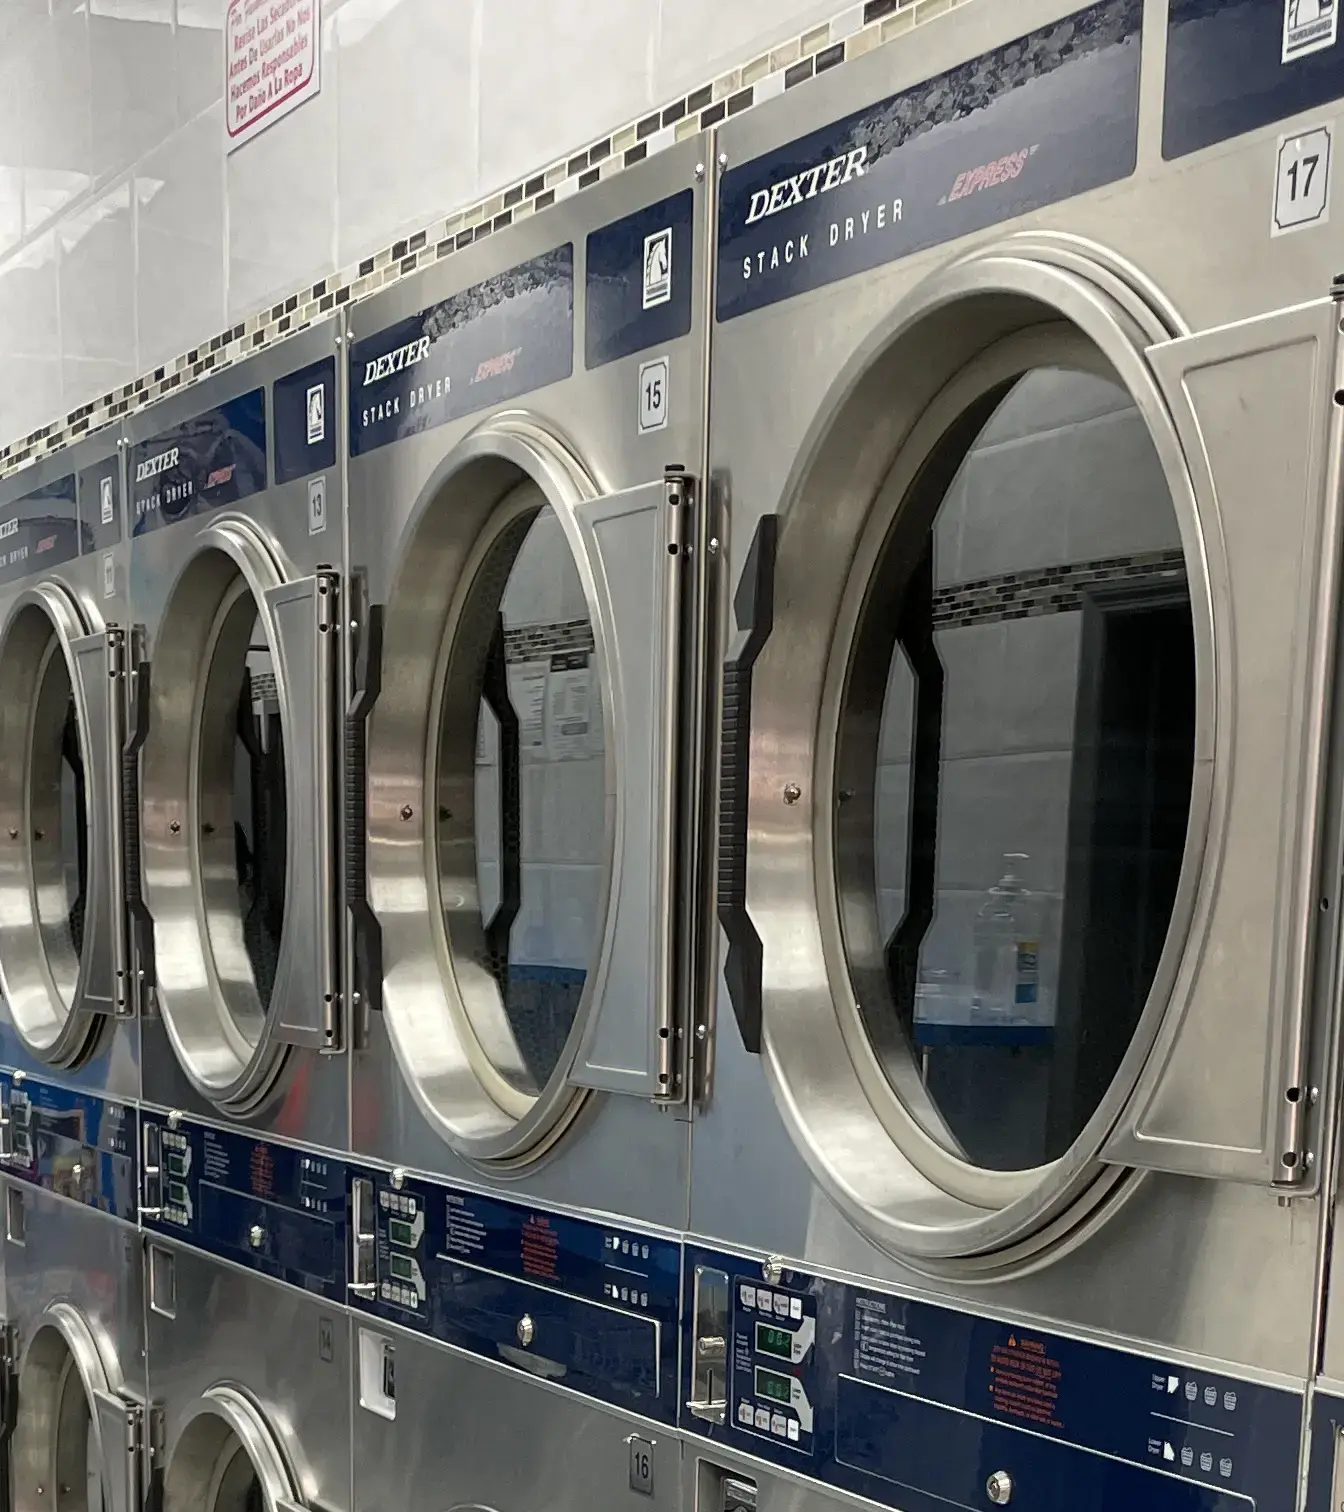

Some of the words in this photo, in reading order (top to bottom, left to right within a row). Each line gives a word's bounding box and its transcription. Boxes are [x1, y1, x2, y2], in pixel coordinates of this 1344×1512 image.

[745, 146, 868, 224] DEXTER
[948, 150, 1028, 202] EXPRESS
[1287, 154, 1319, 201] 17
[743, 234, 809, 279] STACK
[829, 199, 904, 247] DRYER
[363, 335, 431, 386] DEXTER
[362, 396, 400, 427] STACK
[409, 376, 452, 408] DRYER
[645, 379, 662, 412] 15
[136, 447, 179, 483] DEXTER
[312, 493, 323, 518] 13
[635, 1452, 648, 1479] 16
